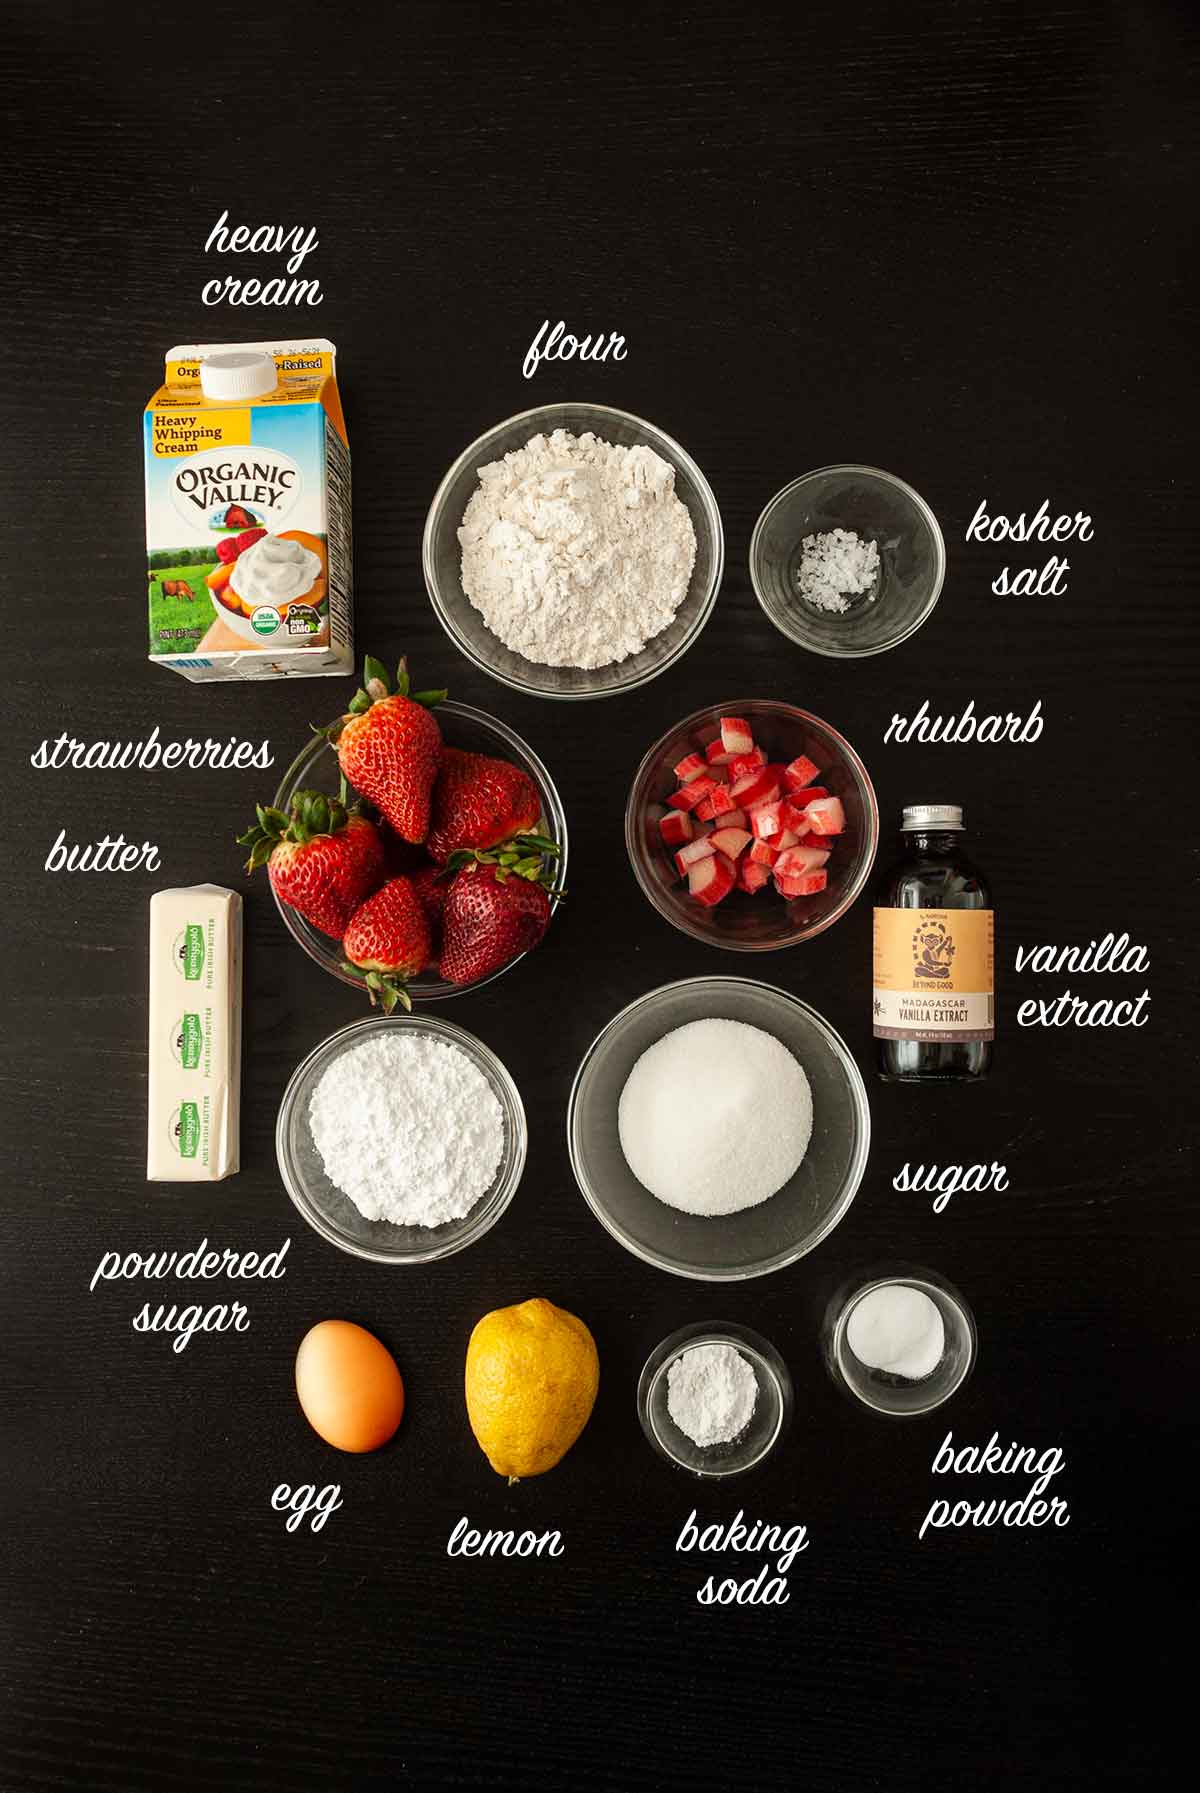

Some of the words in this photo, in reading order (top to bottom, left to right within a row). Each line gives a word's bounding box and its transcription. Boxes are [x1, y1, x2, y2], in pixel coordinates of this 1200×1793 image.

[155, 415, 197, 428] Heavy
[155, 427, 222, 441] Whipping
[154, 442, 199, 454] Cream
[176, 462, 296, 493] ORGANIC
[189, 484, 284, 510] VALLEY
[290, 624, 311, 633] GMO
[902, 999, 965, 1008] MADAGASCAR
[899, 1009, 931, 1021] VANILLA
[934, 1009, 969, 1022] EXTRACT
